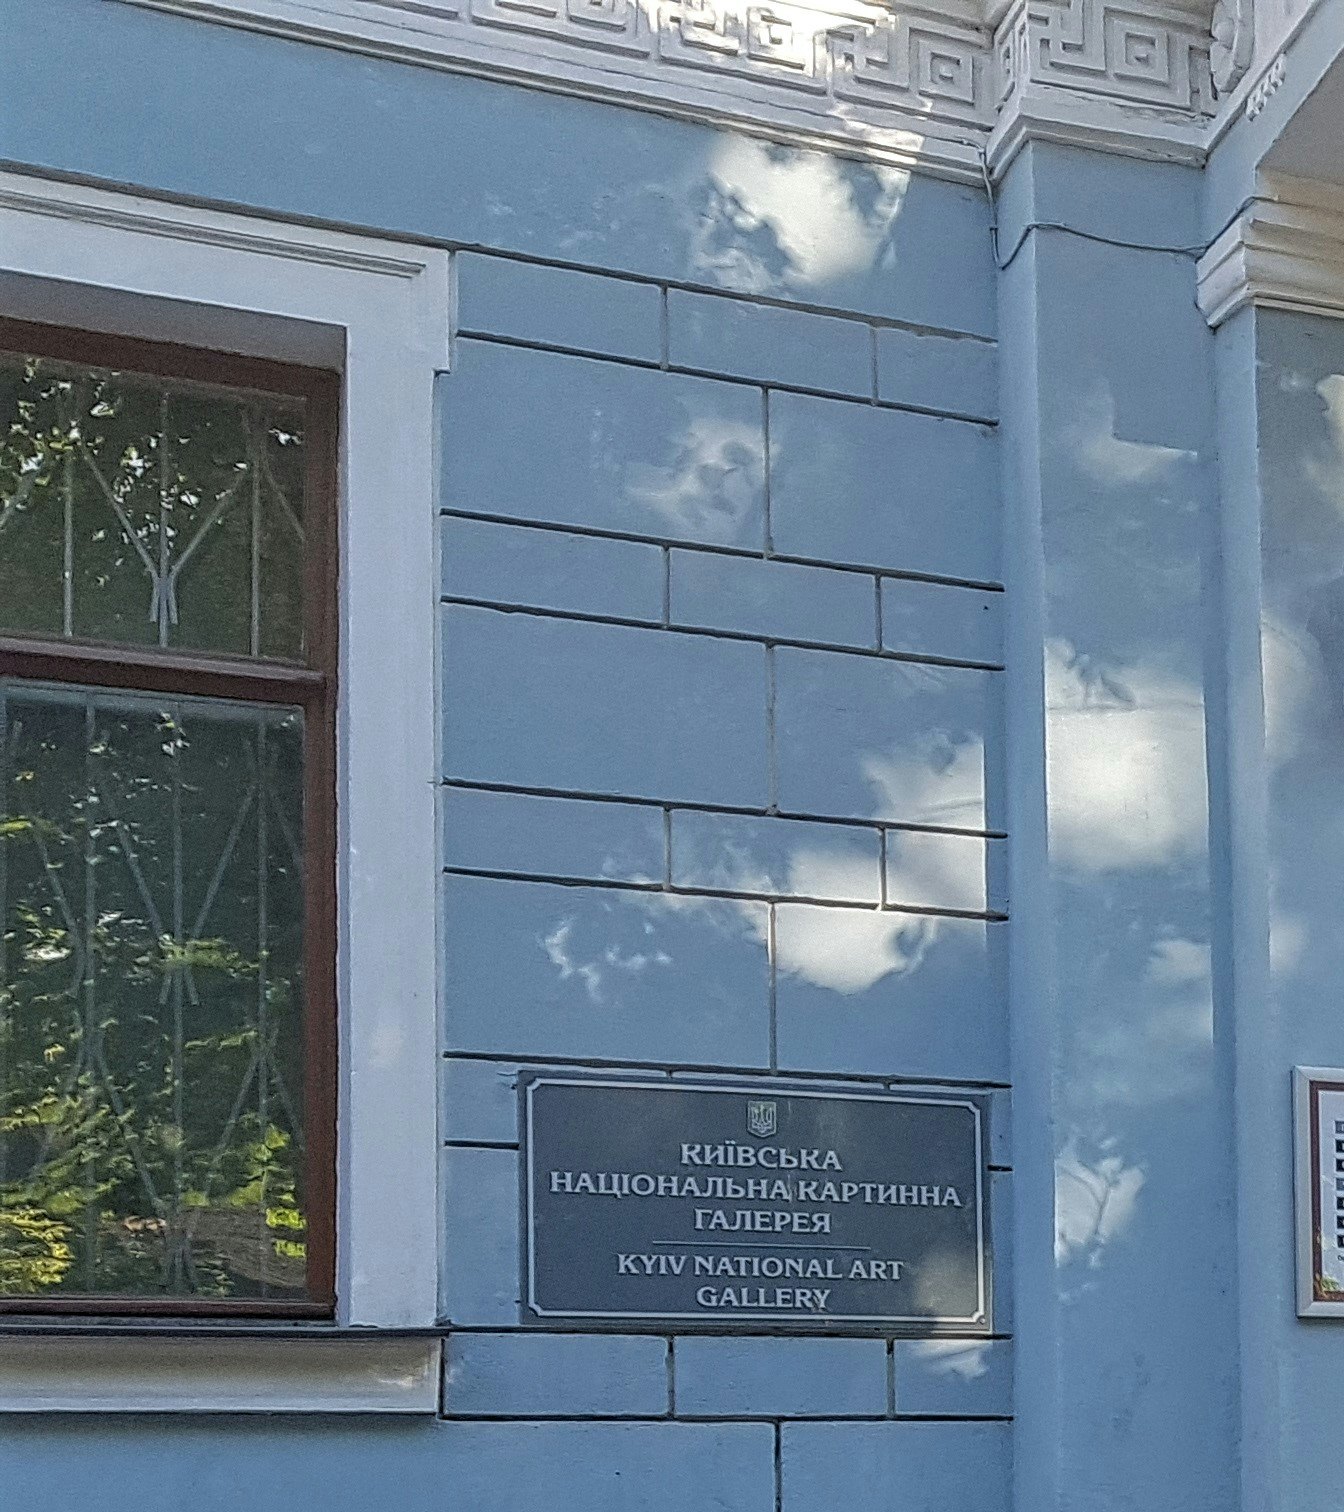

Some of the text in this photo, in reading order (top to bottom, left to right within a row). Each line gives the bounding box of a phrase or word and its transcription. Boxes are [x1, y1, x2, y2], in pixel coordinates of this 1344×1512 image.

[681, 1141, 842, 1171] КИЇВСЬКА
[550, 1171, 963, 1208] НАЦІОНАЛЬНА КАРТИННА
[694, 1209, 831, 1233] ГАЛЕРЕЯ
[617, 1253, 904, 1281] KYIV NATIONAL ART
[696, 1287, 831, 1310] GALLERY
